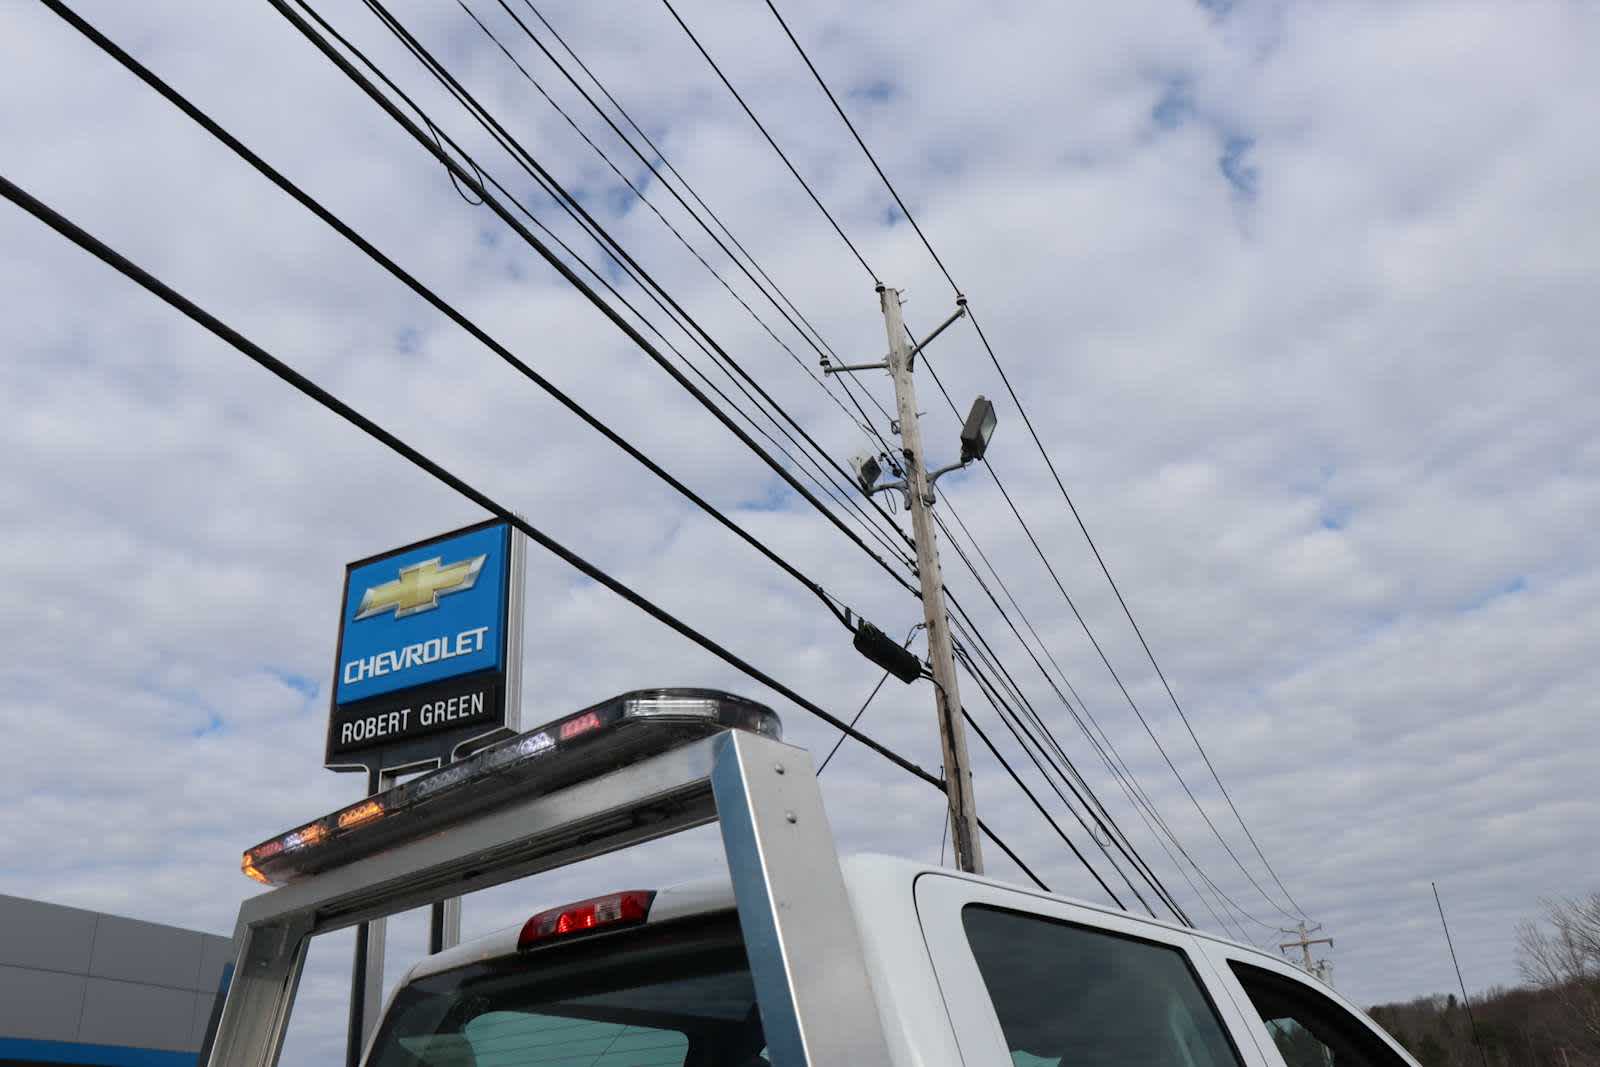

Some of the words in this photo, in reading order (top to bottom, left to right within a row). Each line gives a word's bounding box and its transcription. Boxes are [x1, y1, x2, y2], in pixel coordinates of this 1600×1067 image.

[343, 626, 488, 684] CHEVROLET
[341, 708, 411, 744] ROBERT
[420, 692, 484, 726] GREEN
